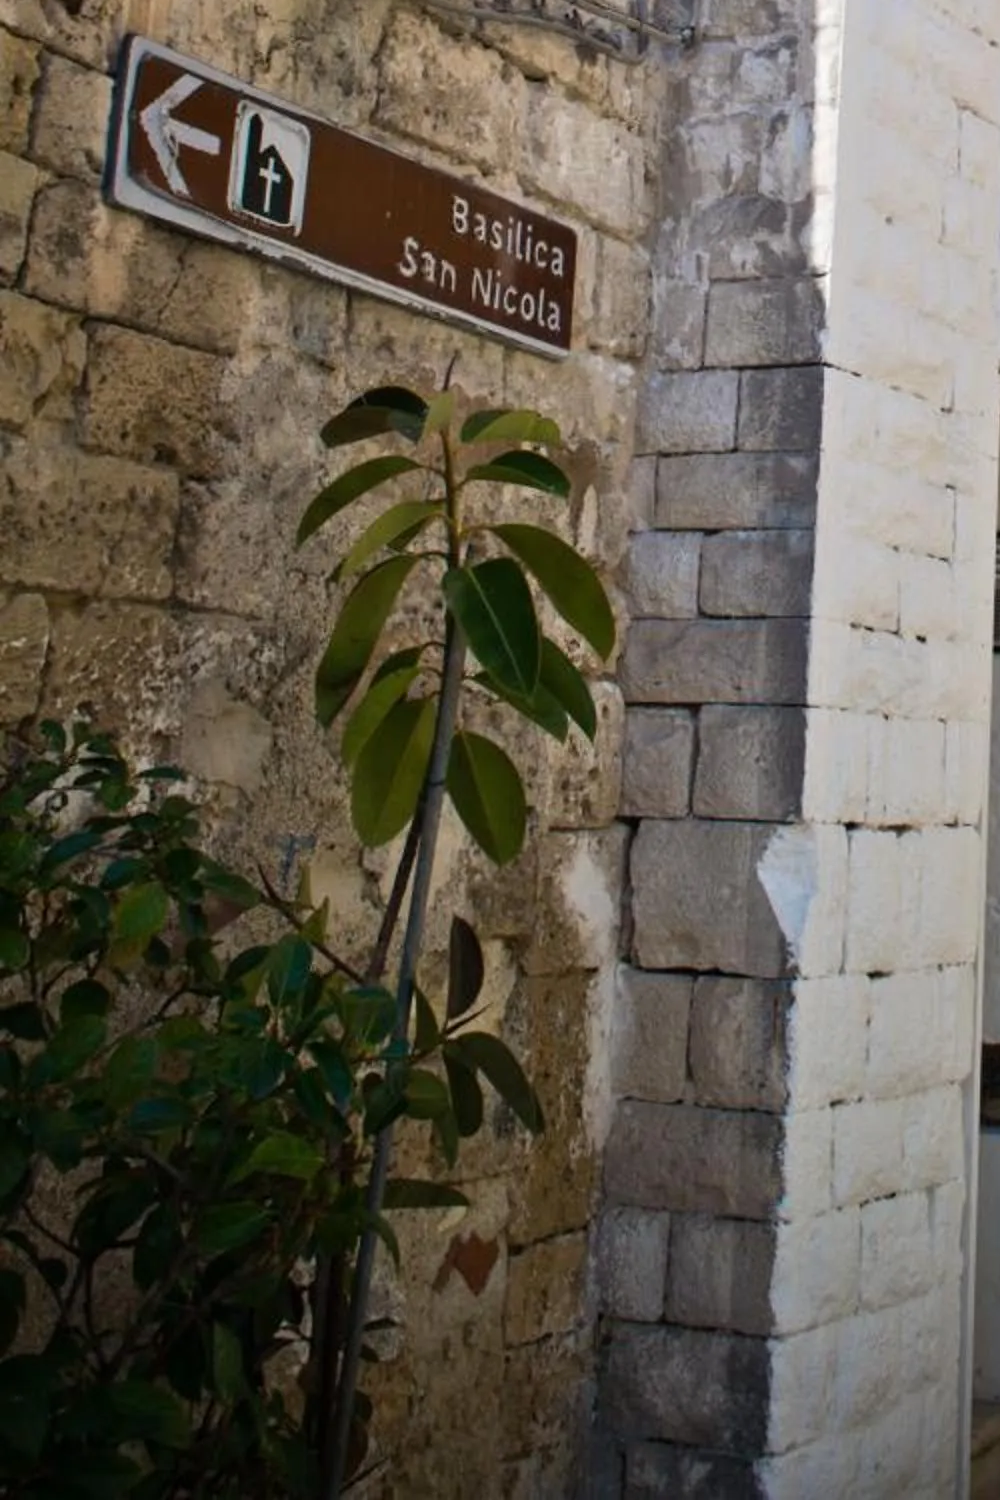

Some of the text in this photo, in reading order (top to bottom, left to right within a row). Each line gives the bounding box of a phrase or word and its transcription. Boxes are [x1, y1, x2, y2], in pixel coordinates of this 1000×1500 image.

[452, 197, 564, 276] Basilica
[399, 237, 561, 332] San Nicola
